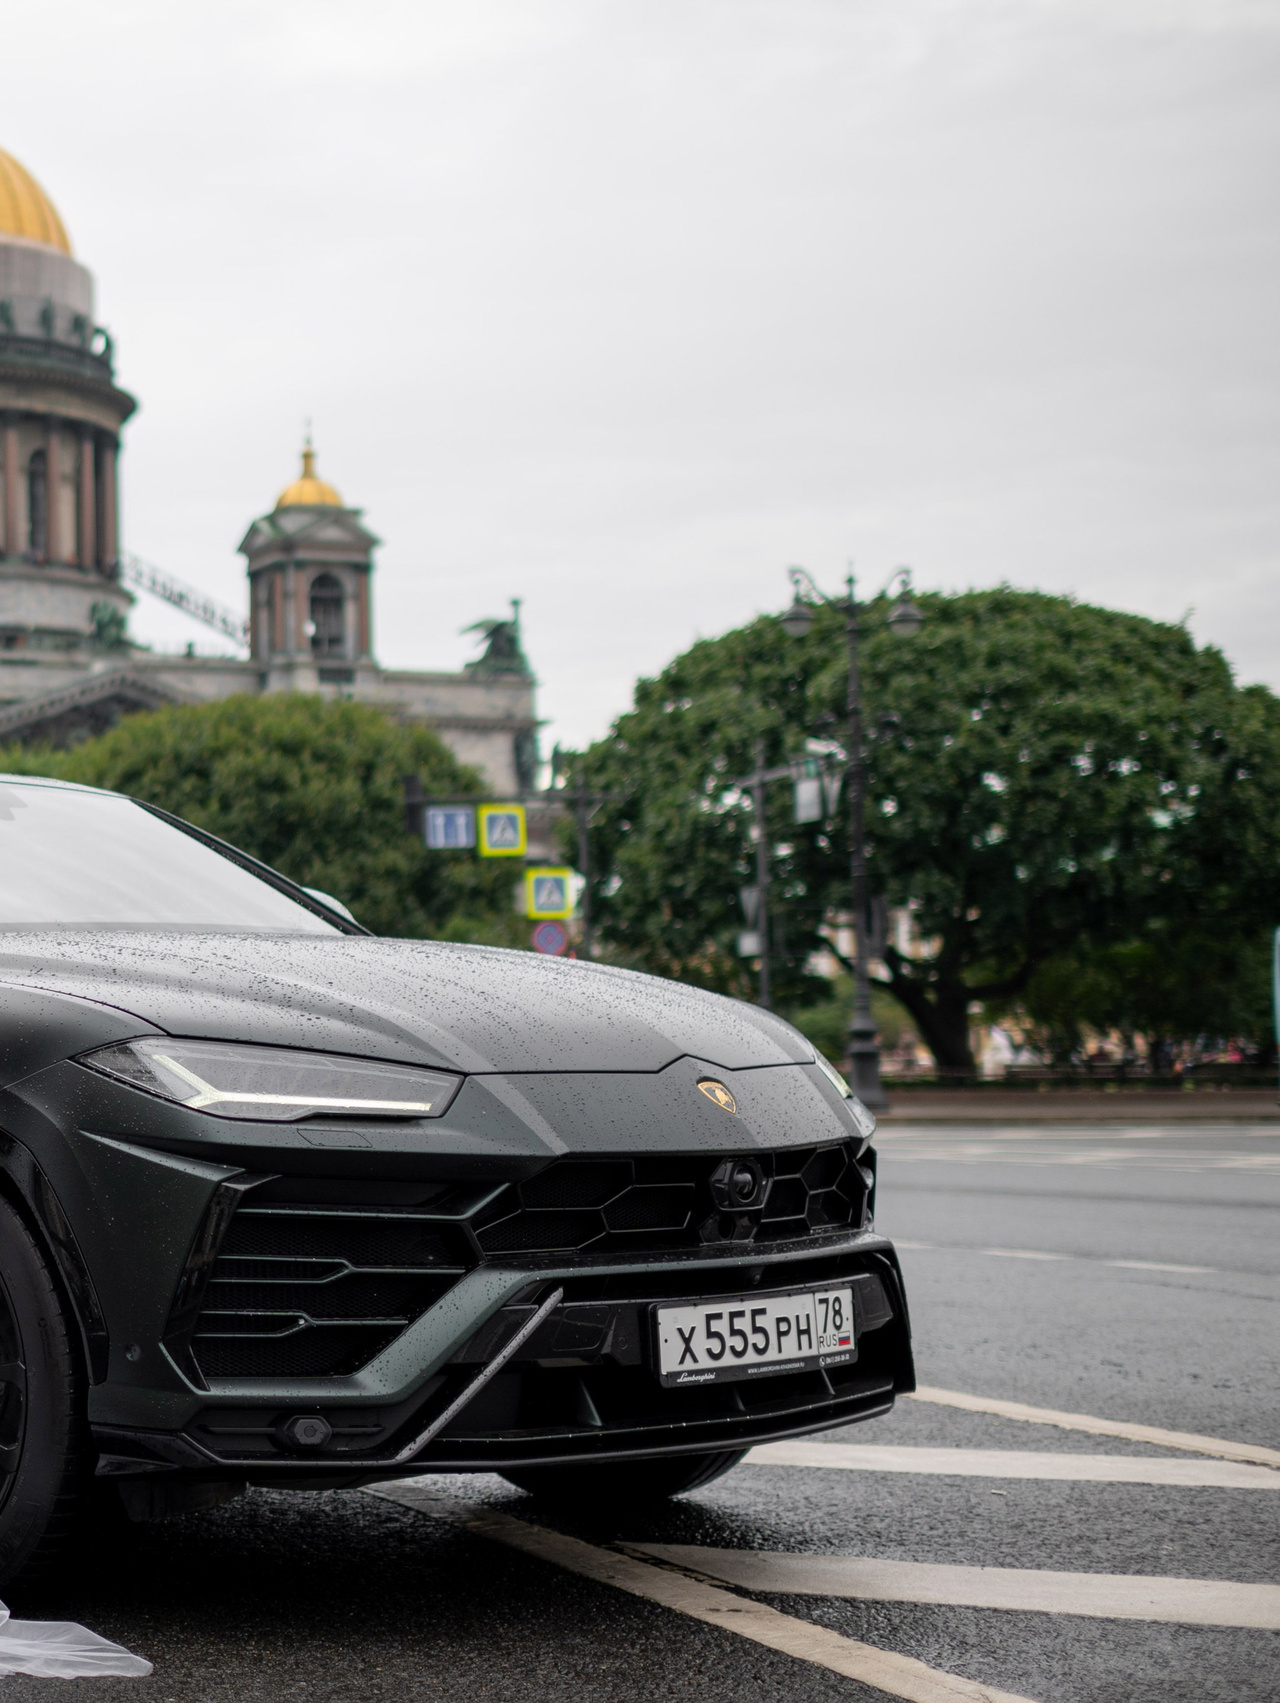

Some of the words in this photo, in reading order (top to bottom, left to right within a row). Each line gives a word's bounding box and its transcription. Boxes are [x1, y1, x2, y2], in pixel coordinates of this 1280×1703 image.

[818, 1296, 844, 1334] 78
[819, 1333, 838, 1348] RUS
[676, 1371, 716, 1383] Lamborghini
